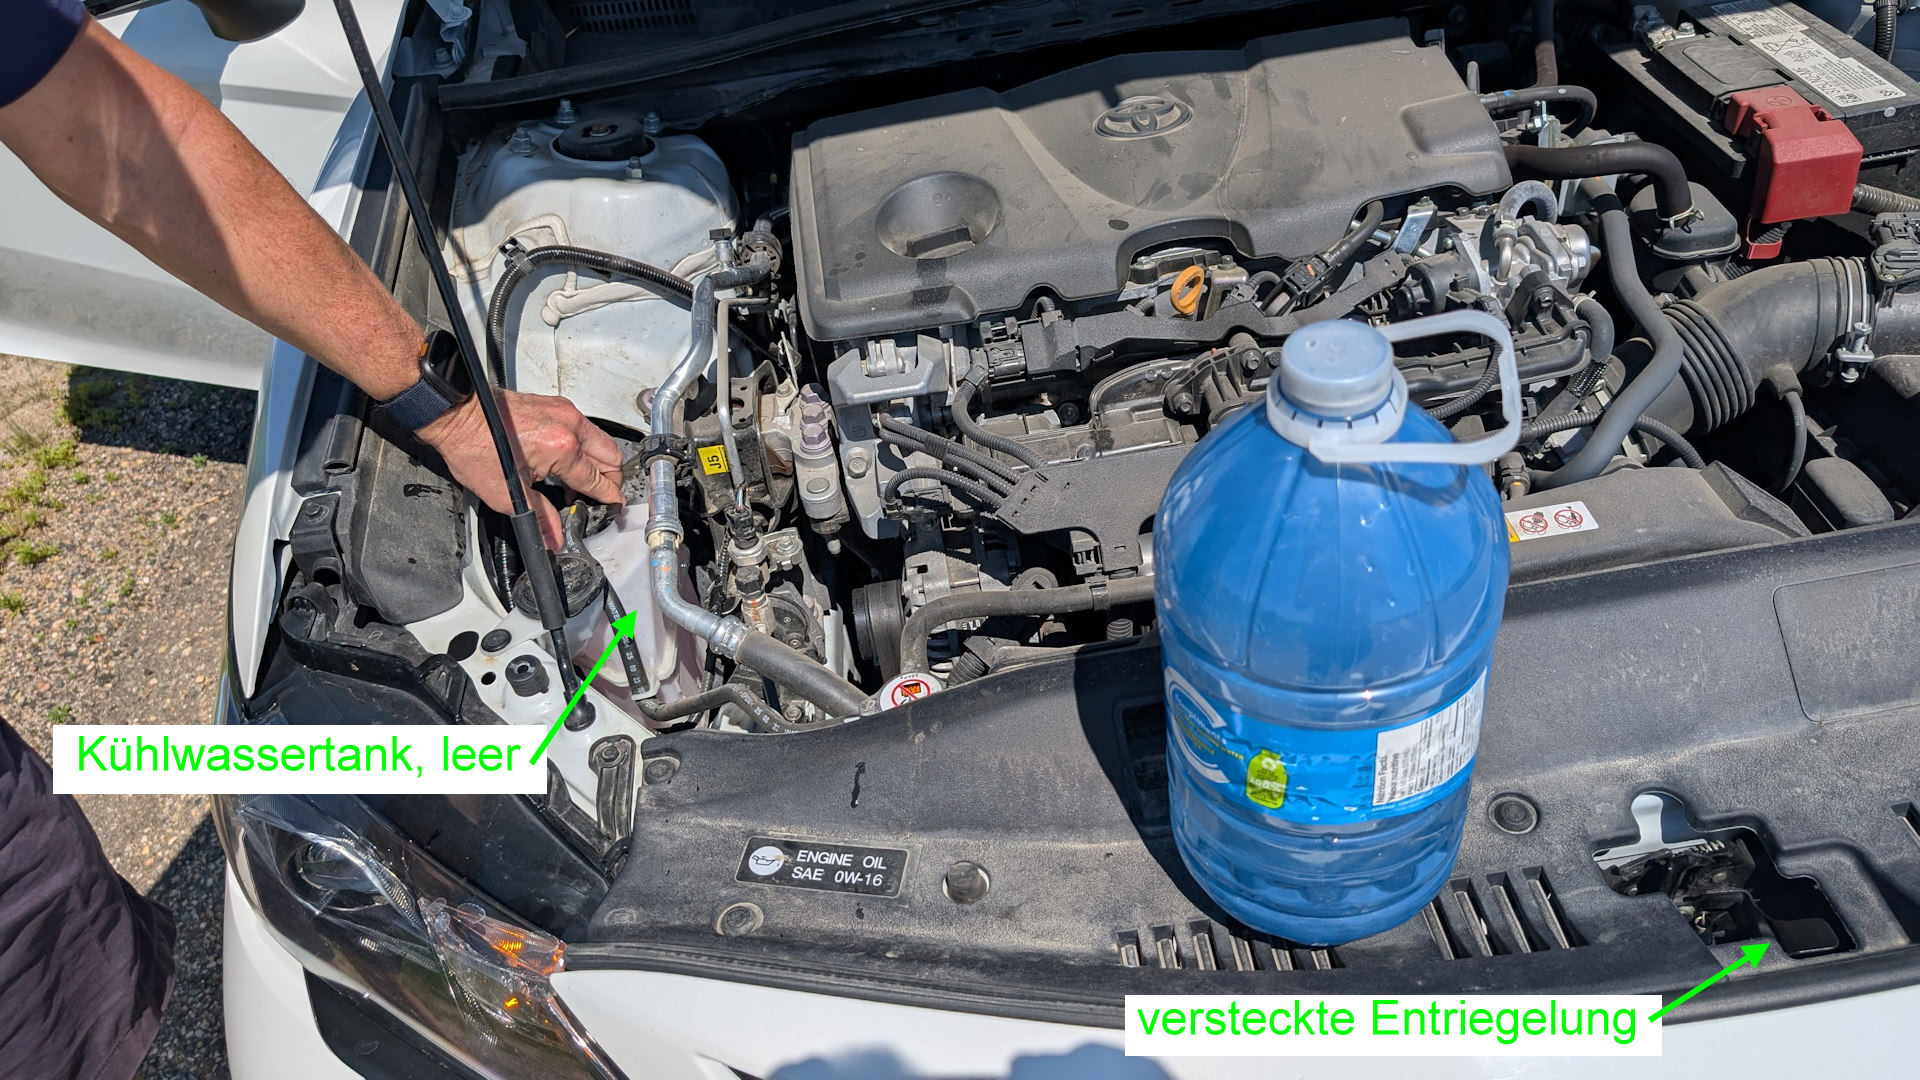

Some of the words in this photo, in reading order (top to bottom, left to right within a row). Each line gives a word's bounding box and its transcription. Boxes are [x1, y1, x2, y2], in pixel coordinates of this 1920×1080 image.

[707, 455, 722, 469] J5
[607, 600, 622, 621] WATE
[796, 849, 854, 867] ENGINE
[862, 855, 887, 870] OIL
[791, 866, 825, 881] SAE
[834, 870, 883, 887] 0W-16
